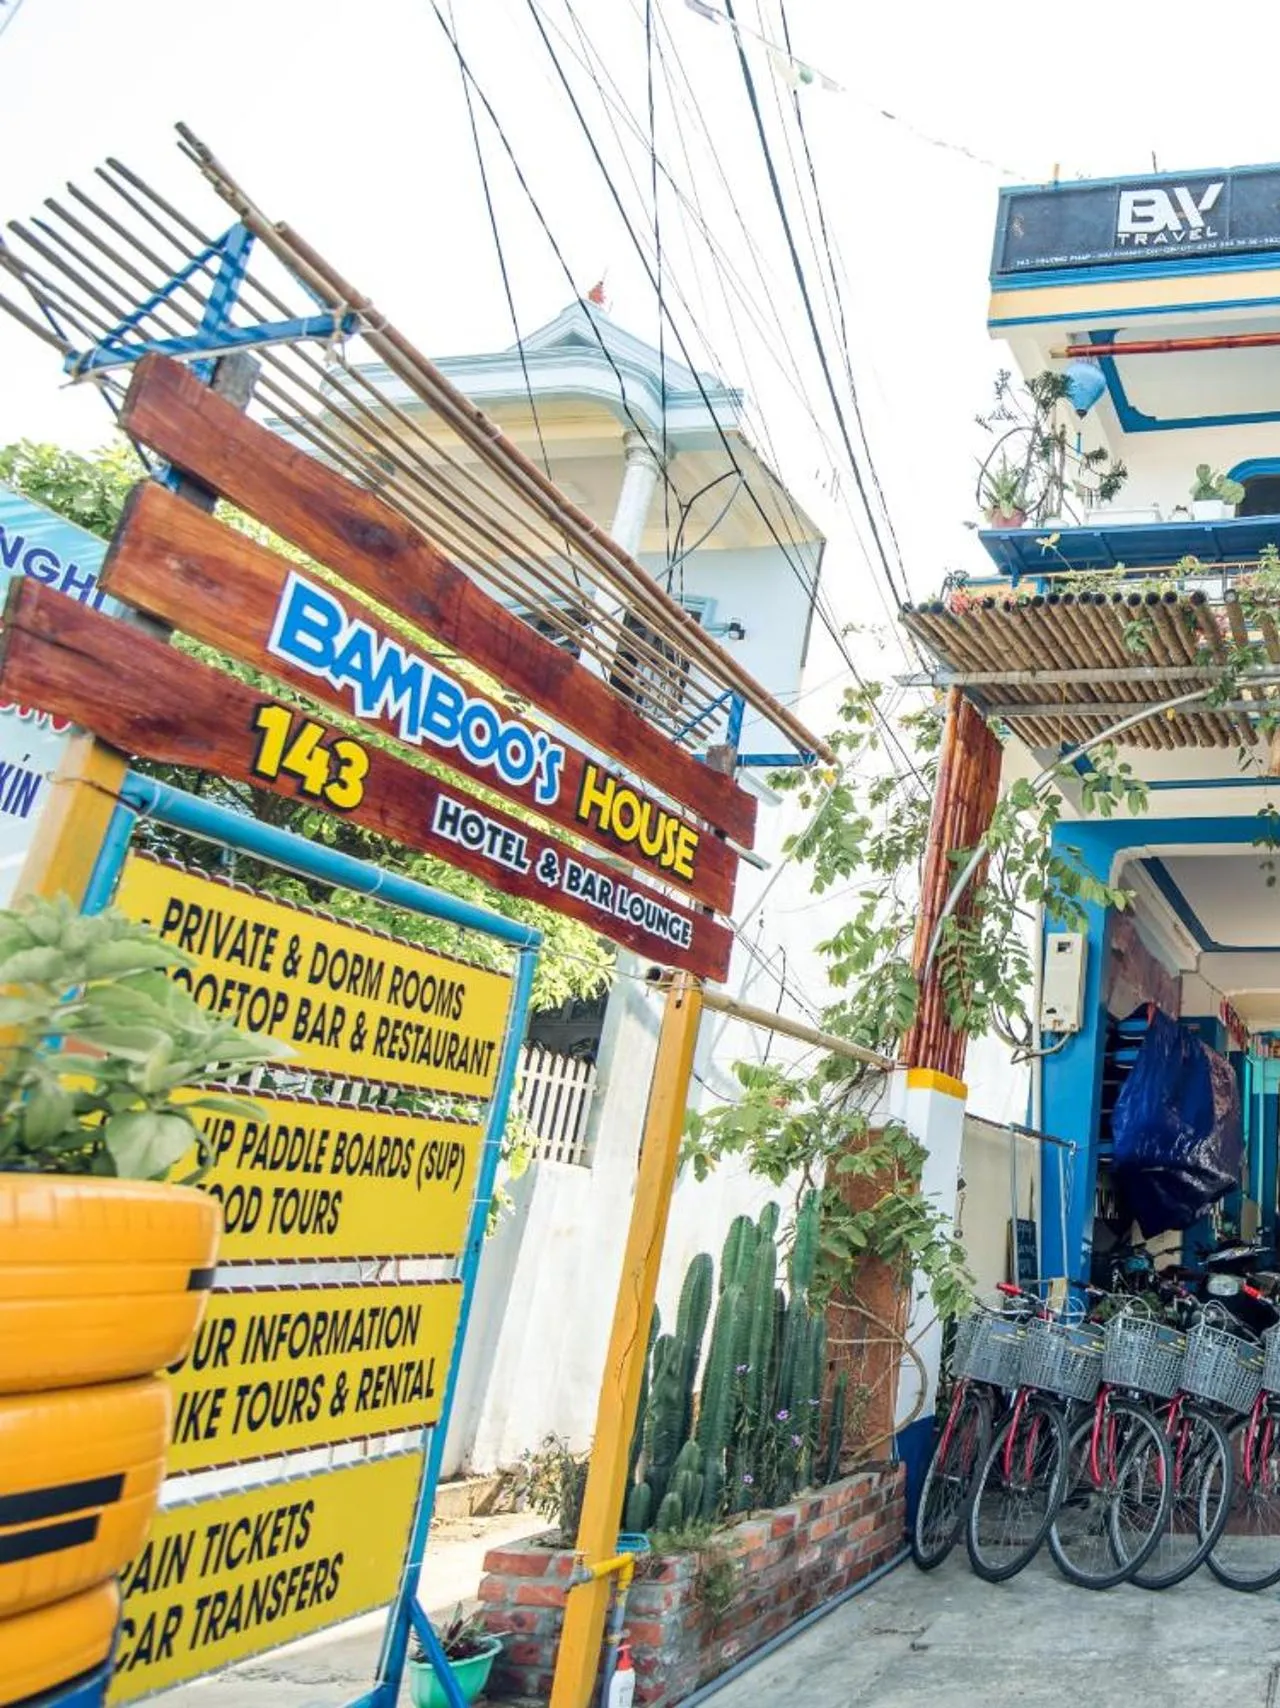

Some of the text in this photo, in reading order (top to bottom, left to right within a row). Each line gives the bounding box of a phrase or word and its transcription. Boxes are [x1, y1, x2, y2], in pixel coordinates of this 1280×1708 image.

[1117, 226, 1218, 245] TRAVEL
[252, 703, 371, 811] 143
[269, 572, 698, 880] BAMBOO'S HOUSE
[433, 795, 692, 948] HOTEL & BAR LOUNGE
[160, 897, 465, 1021] PRIVATE & DORM ROOMS
[292, 1002, 345, 1050] BAR
[351, 1018, 367, 1053] &
[373, 1020, 496, 1078] RESTAURANT
[237, 1120, 330, 1174] PADDLE
[333, 1132, 415, 1180] BOARDS
[416, 1141, 465, 1191] (SUP)
[266, 1188, 342, 1235] TOURS
[241, 1305, 422, 1365] INFORMATION
[232, 1374, 325, 1435] TOURS
[330, 1375, 349, 1417] &
[355, 1357, 435, 1412] RENTAL
[200, 1500, 315, 1577] TICKETS
[187, 1551, 344, 1650] TRANSFERS
